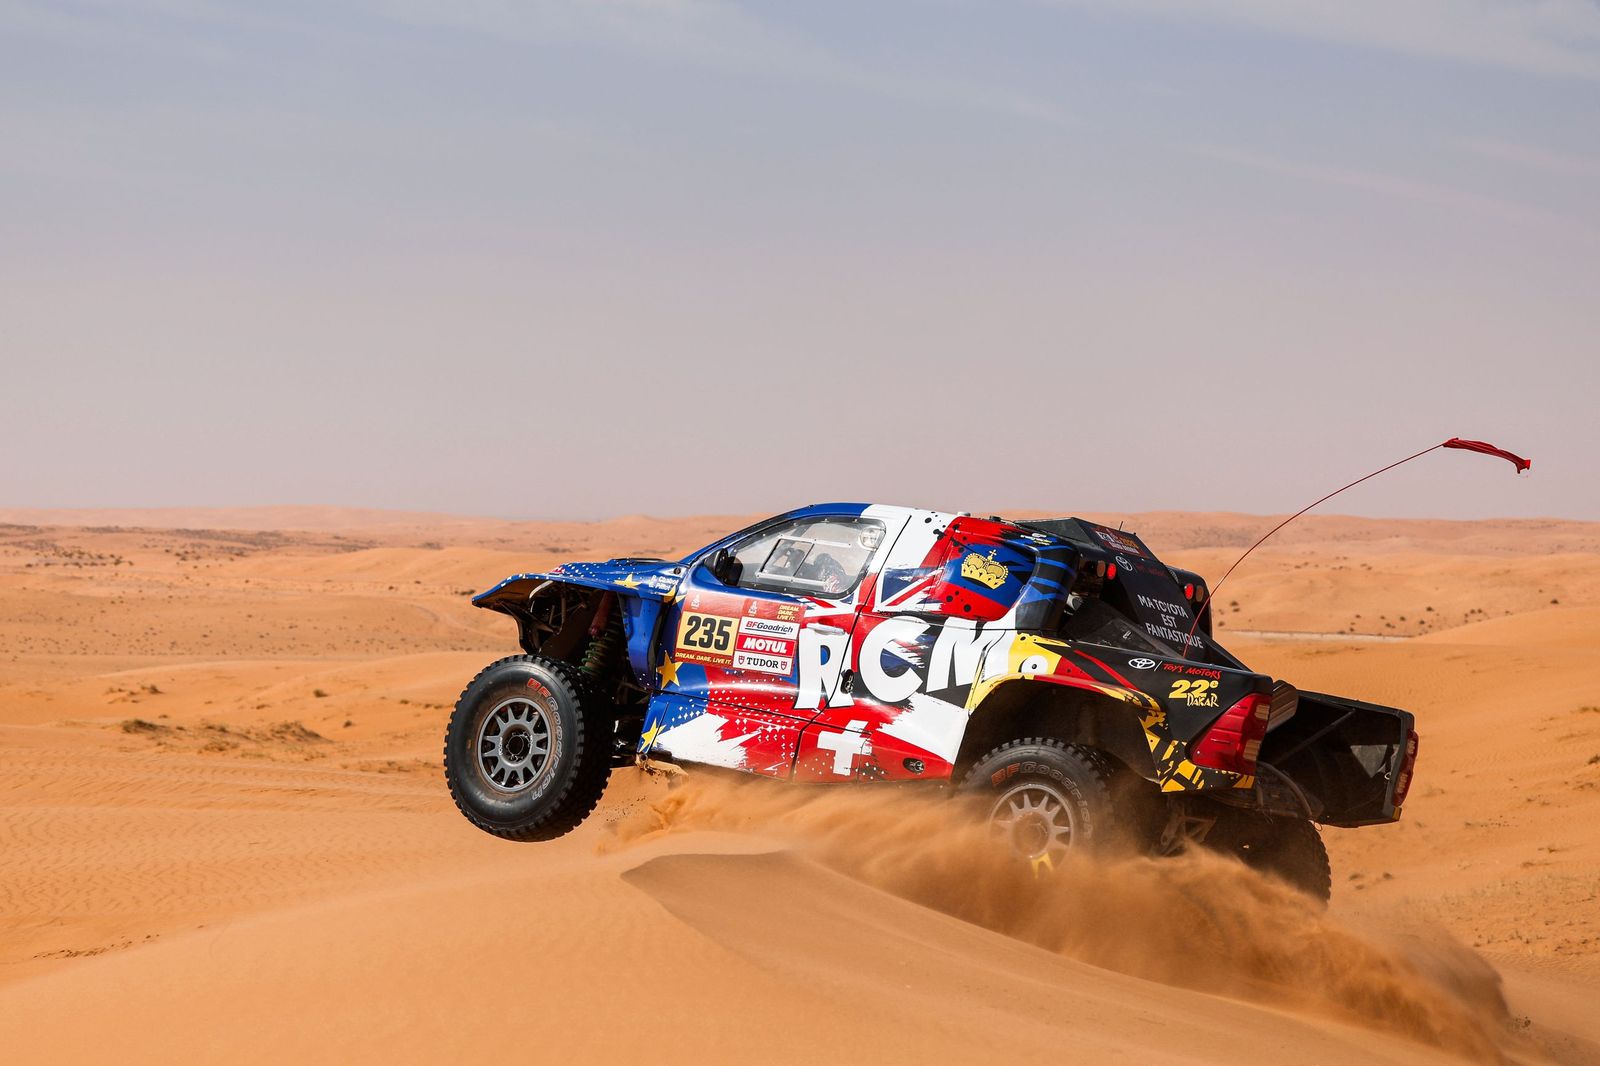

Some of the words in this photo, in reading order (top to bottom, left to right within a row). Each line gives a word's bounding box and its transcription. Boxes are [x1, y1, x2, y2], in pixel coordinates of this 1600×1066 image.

[745, 620, 794, 633] BFGoodrich
[1161, 613, 1177, 628] EST
[683, 615, 733, 651] 235
[1145, 622, 1204, 649] FANTASTIQUE
[743, 637, 788, 654] MOTUL
[675, 652, 696, 660] DREAM.
[746, 656, 779, 669] TUDOR
[794, 614, 1015, 710] RCM
